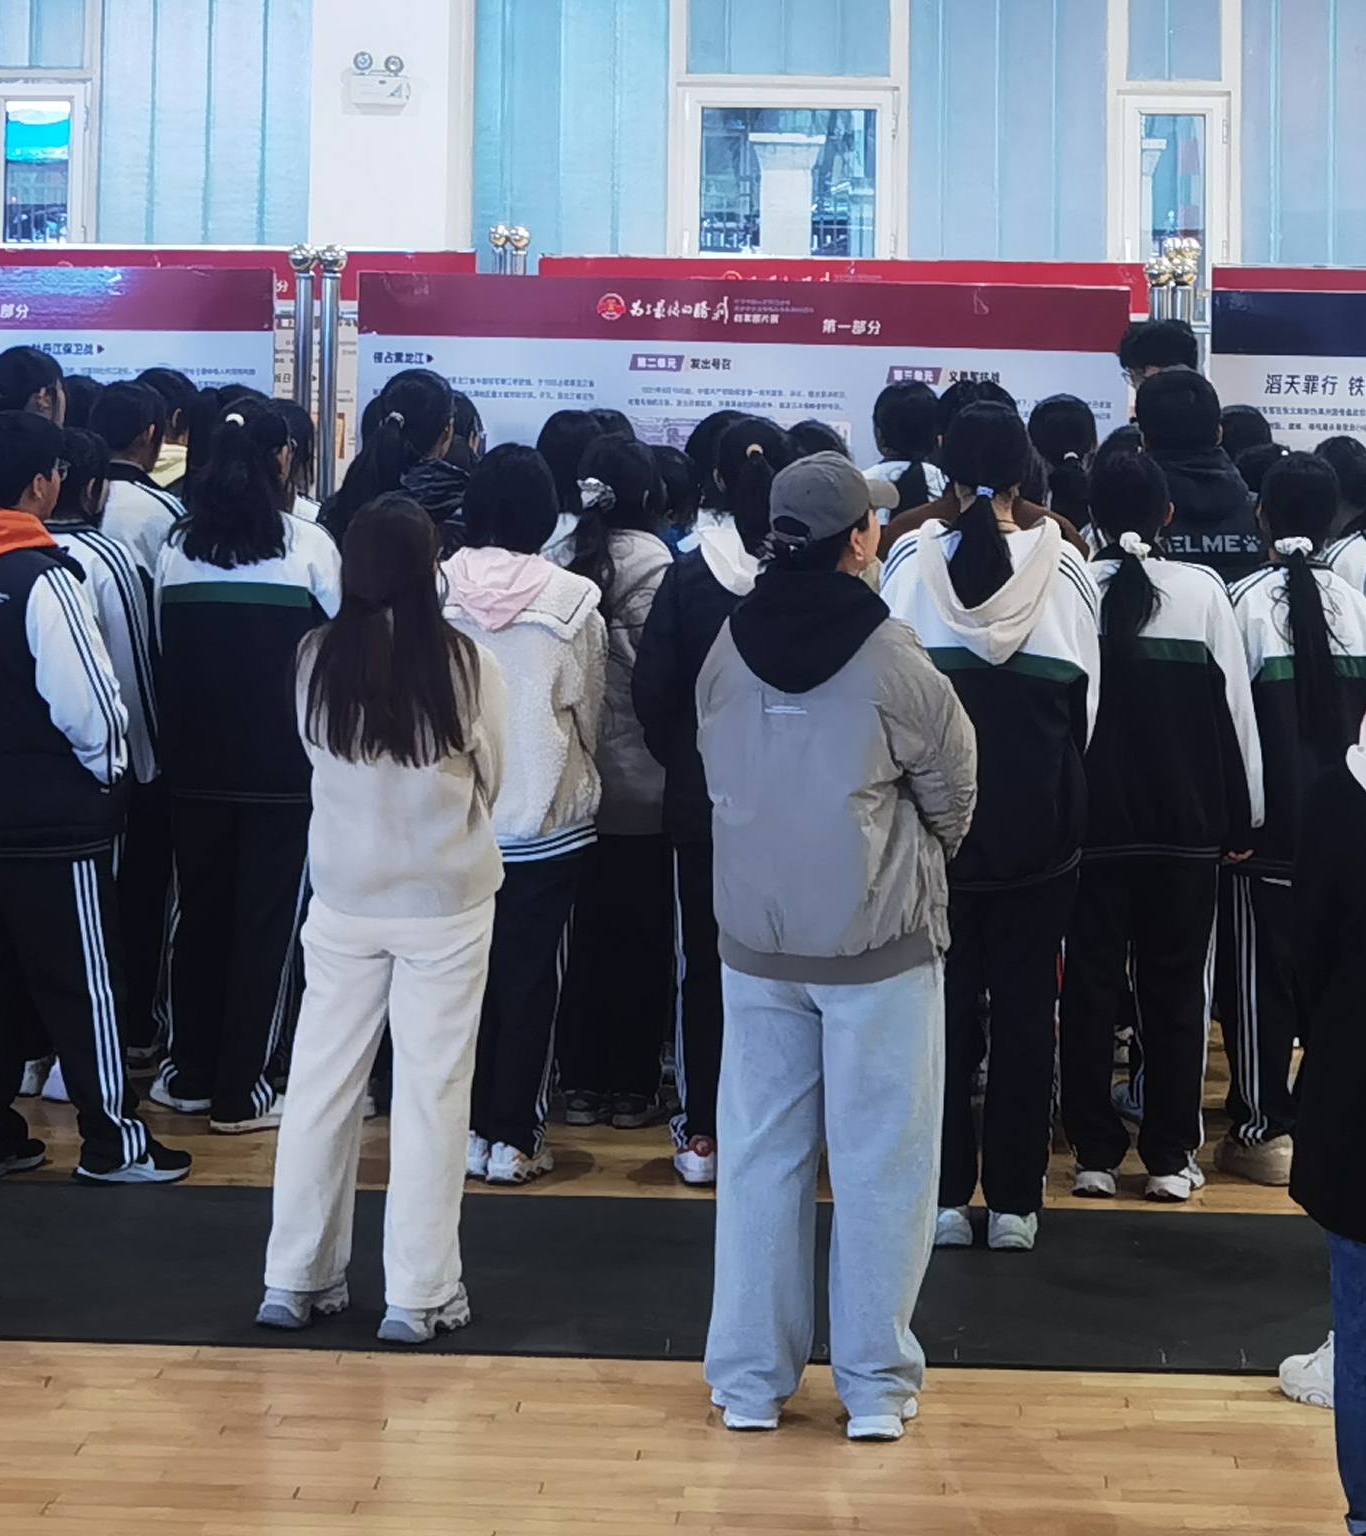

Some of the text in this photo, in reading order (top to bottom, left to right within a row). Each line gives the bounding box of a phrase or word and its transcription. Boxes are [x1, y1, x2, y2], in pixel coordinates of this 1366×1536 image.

[822, 318, 882, 335] 第一部分
[689, 357, 732, 371] 发出号召
[1264, 373, 1339, 396] 滔天罪行
[1162, 534, 1241, 553] ELME
